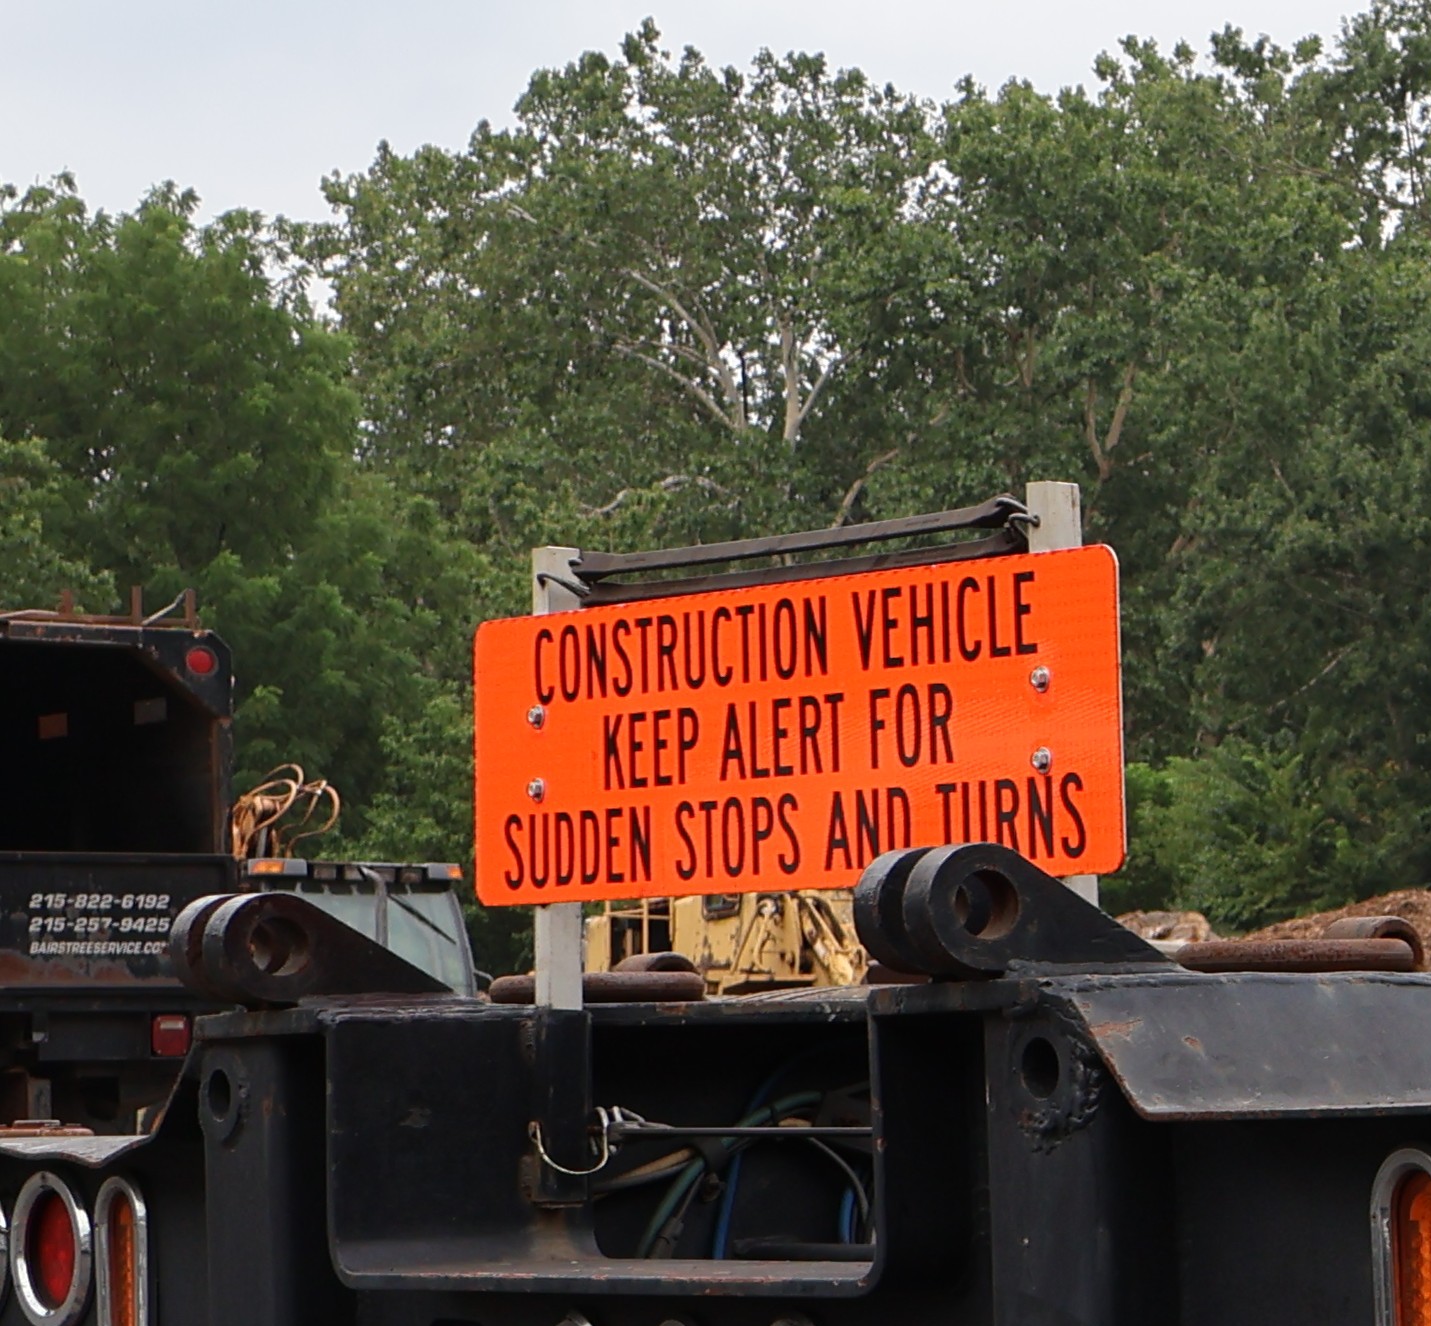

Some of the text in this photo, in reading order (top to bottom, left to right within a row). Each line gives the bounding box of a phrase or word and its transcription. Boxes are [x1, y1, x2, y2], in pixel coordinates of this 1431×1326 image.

[534, 570, 1039, 706] CONSTRUCTION VEHICLE
[603, 682, 955, 791] KEEP ALERT FOR
[503, 771, 1087, 891] SUDDEN STOPS AND TURNS
[28, 892, 171, 910] 215-822-6192
[28, 916, 171, 933] 215-257-9425
